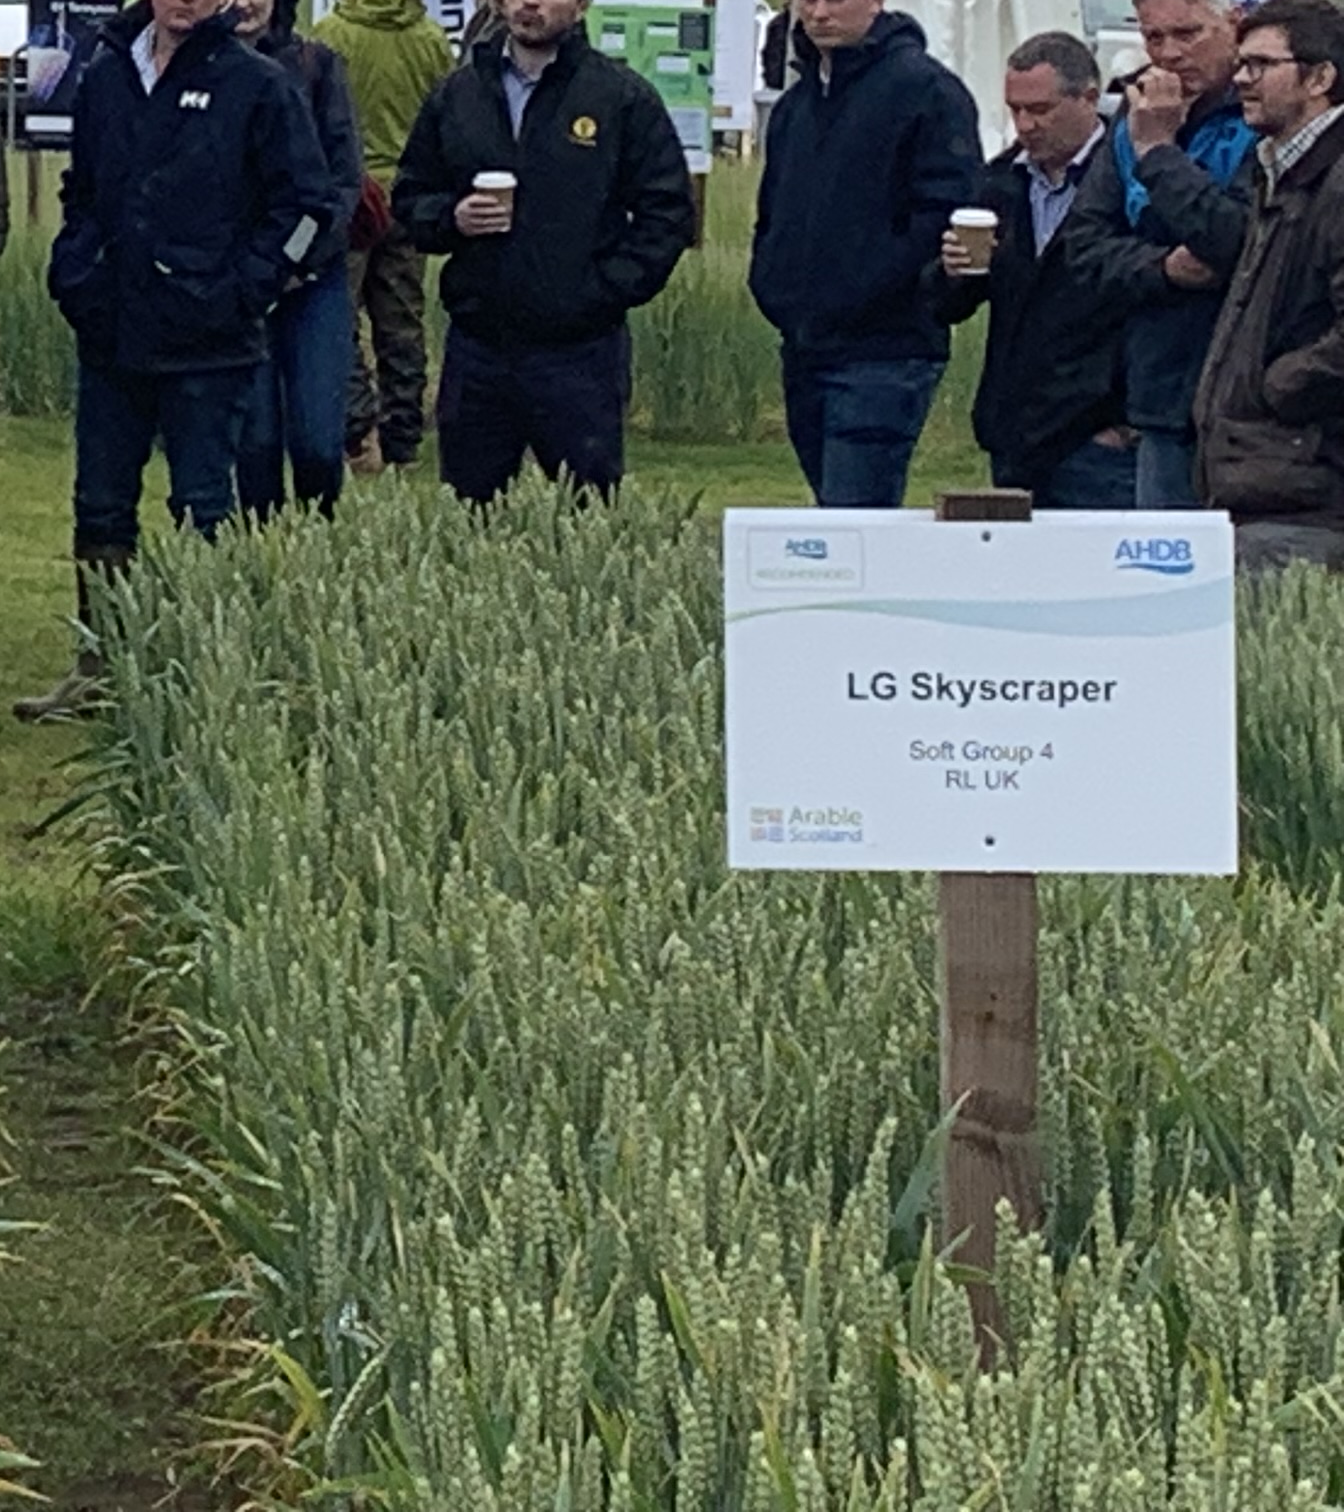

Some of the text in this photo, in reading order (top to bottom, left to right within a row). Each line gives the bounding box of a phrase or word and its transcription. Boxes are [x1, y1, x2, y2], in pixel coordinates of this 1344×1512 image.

[1115, 538, 1193, 562] AHDB
[847, 672, 1118, 708] LG Skyscraper
[909, 740, 1054, 767] Soft Group 4
[945, 770, 1020, 791] RL UK
[788, 807, 862, 827] Arable
